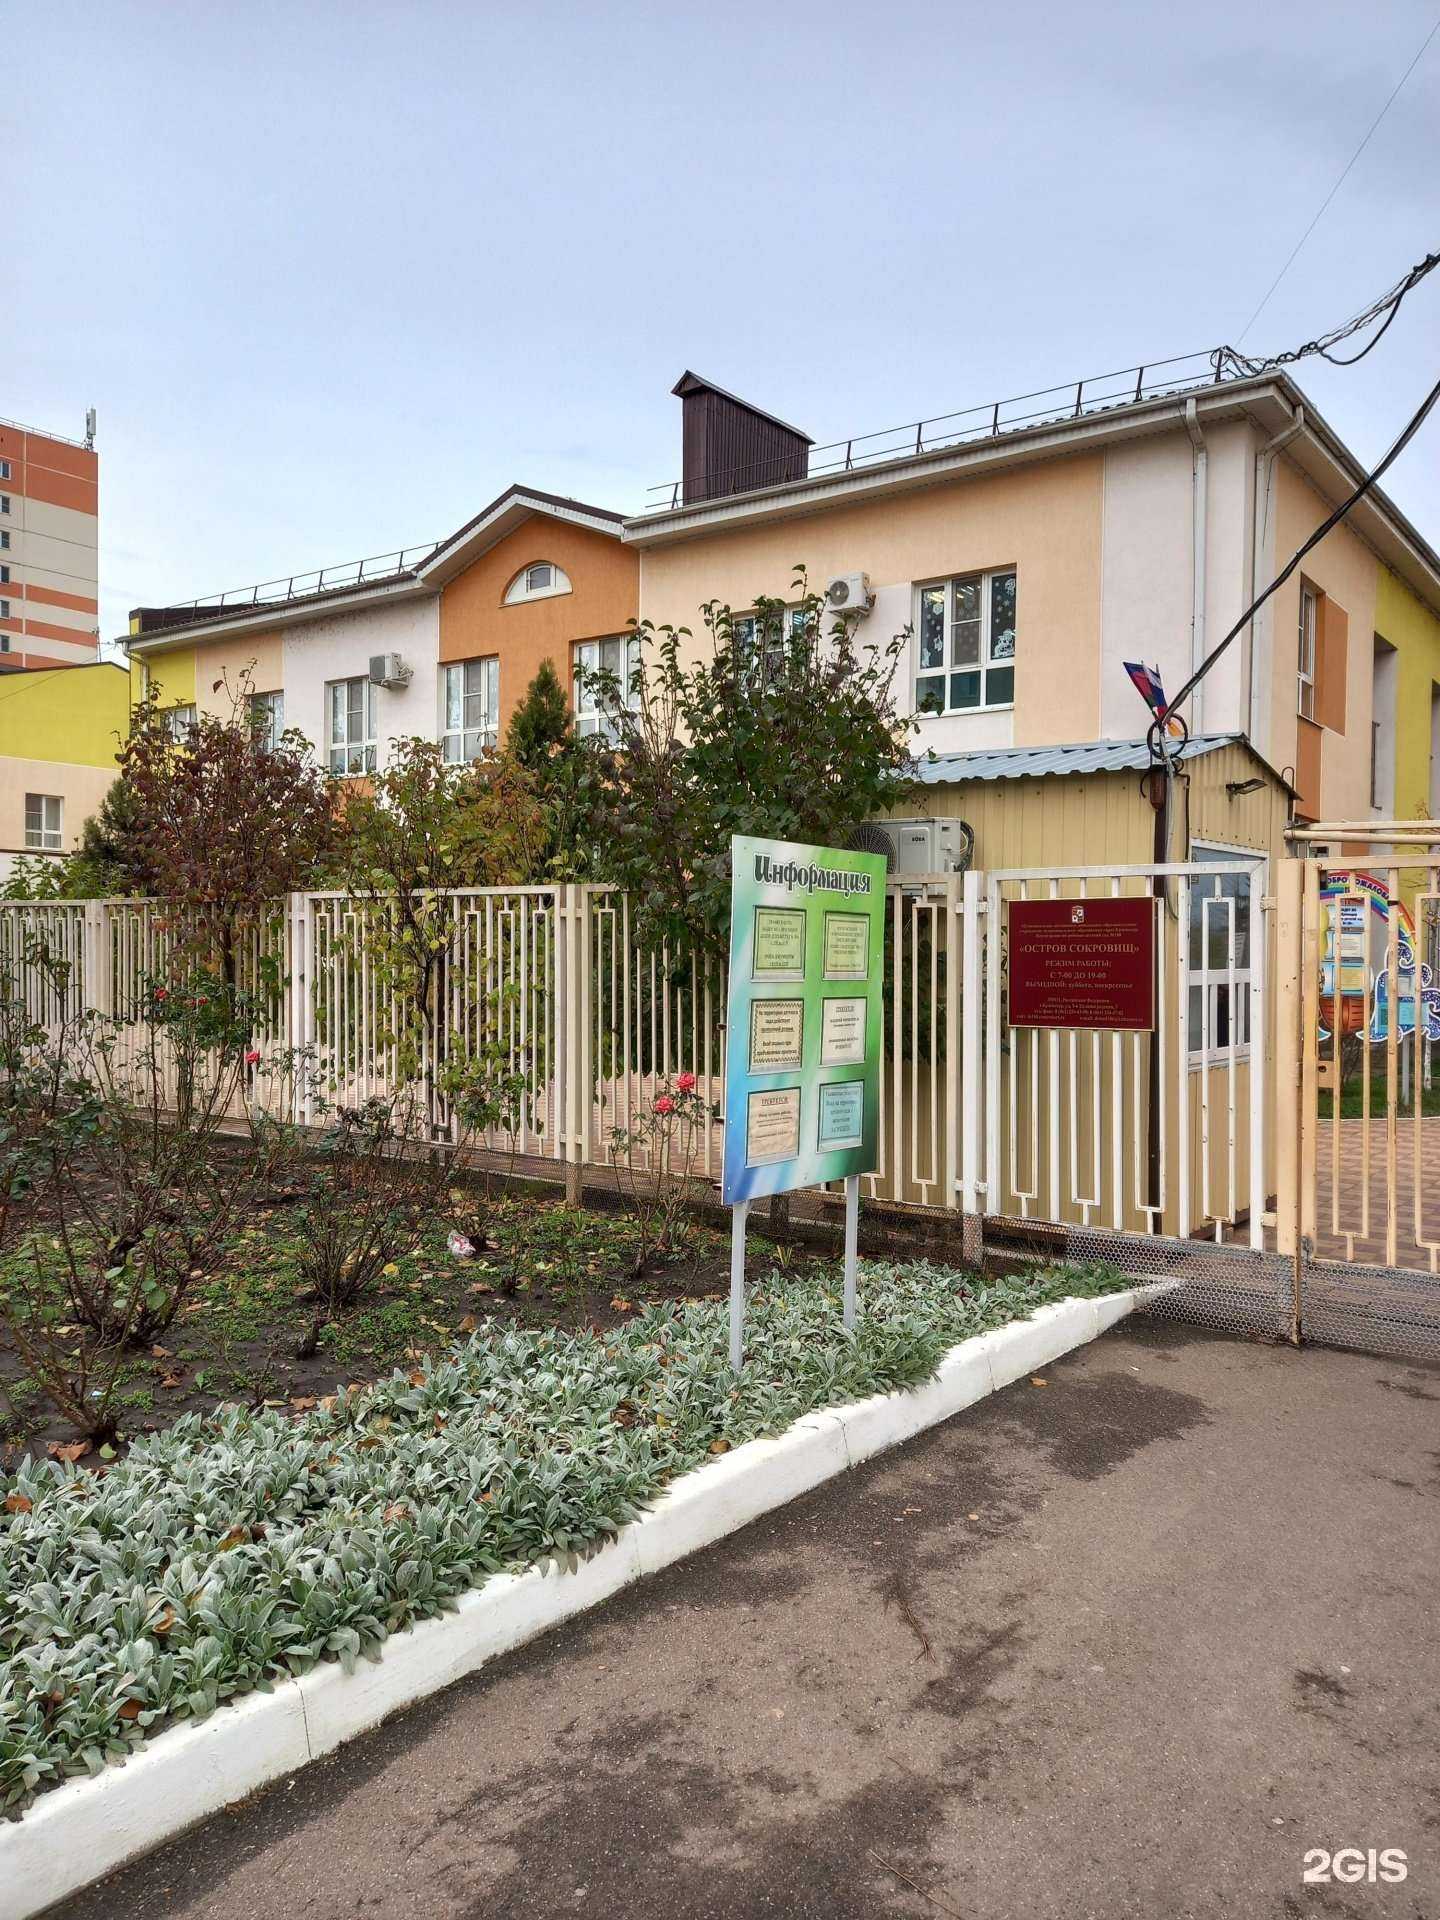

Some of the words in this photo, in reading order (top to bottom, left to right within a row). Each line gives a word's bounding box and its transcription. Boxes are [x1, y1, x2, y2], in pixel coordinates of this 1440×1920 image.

[754, 854, 872, 897] Информация
[1327, 876, 1348, 884] ОБРО
[1020, 943, 1067, 954] «ОСТРОВ
[1069, 943, 1140, 955] СОКРОВИЩ»
